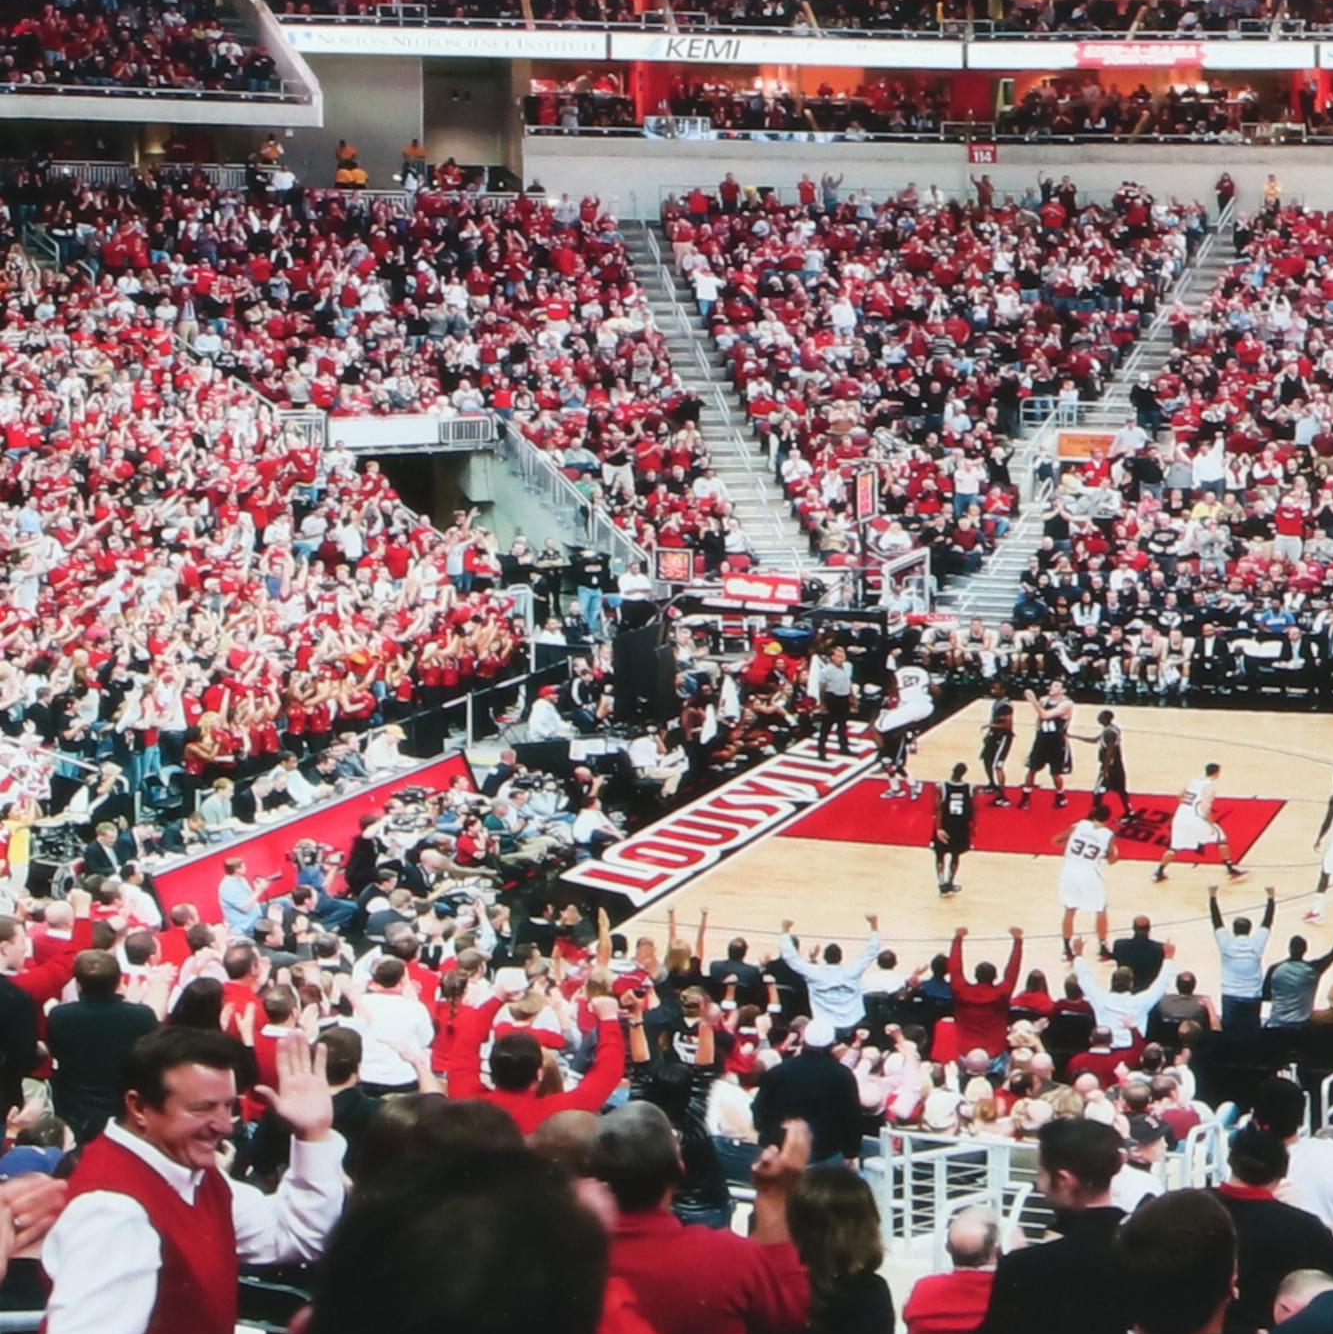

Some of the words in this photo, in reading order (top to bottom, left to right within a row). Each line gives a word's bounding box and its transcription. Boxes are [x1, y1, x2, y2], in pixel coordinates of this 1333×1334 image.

[664, 37, 741, 60] KEMI
[974, 150, 994, 164] 114
[1070, 839, 1101, 860] 33
